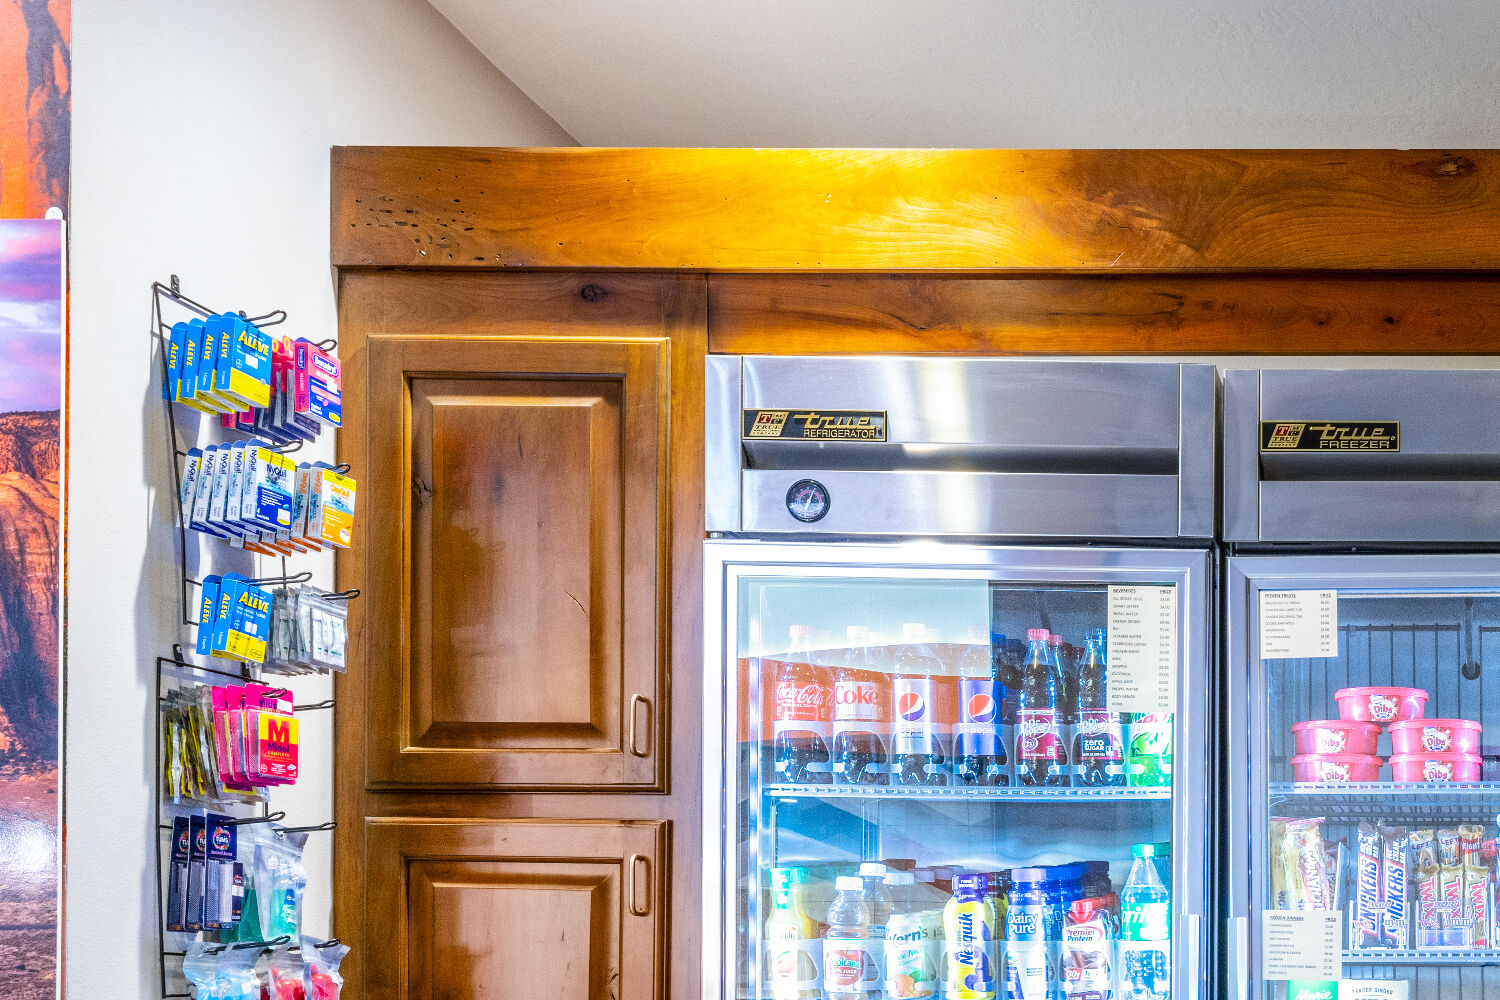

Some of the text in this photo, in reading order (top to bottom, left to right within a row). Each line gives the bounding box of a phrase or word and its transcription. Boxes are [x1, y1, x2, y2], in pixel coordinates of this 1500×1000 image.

[186, 339, 196, 366] ALEVE
[204, 334, 213, 360] ALEVE
[221, 331, 230, 358] ALEVE
[238, 331, 269, 356] ALEVE
[169, 342, 178, 369] ALEVE
[804, 429, 875, 438] REFRIGERATOR
[1320, 441, 1389, 449] FREEZER
[202, 596, 212, 624] ALEVE
[220, 593, 230, 619] ALEVE
[239, 592, 269, 613] ALEVE
[836, 685, 878, 705] Coke
[1374, 703, 1393, 713] Dibs
[268, 719, 290, 743] M
[1427, 736, 1446, 746] Dibs
[267, 742, 290, 753] Midol
[1084, 739, 1104, 747] zero
[1326, 771, 1345, 780] Dibs
[1428, 771, 1447, 780] Dibs
[1471, 878, 1486, 921] TWIX
[1008, 912, 1038, 926] Dairy
[1008, 923, 1036, 936] Pure
